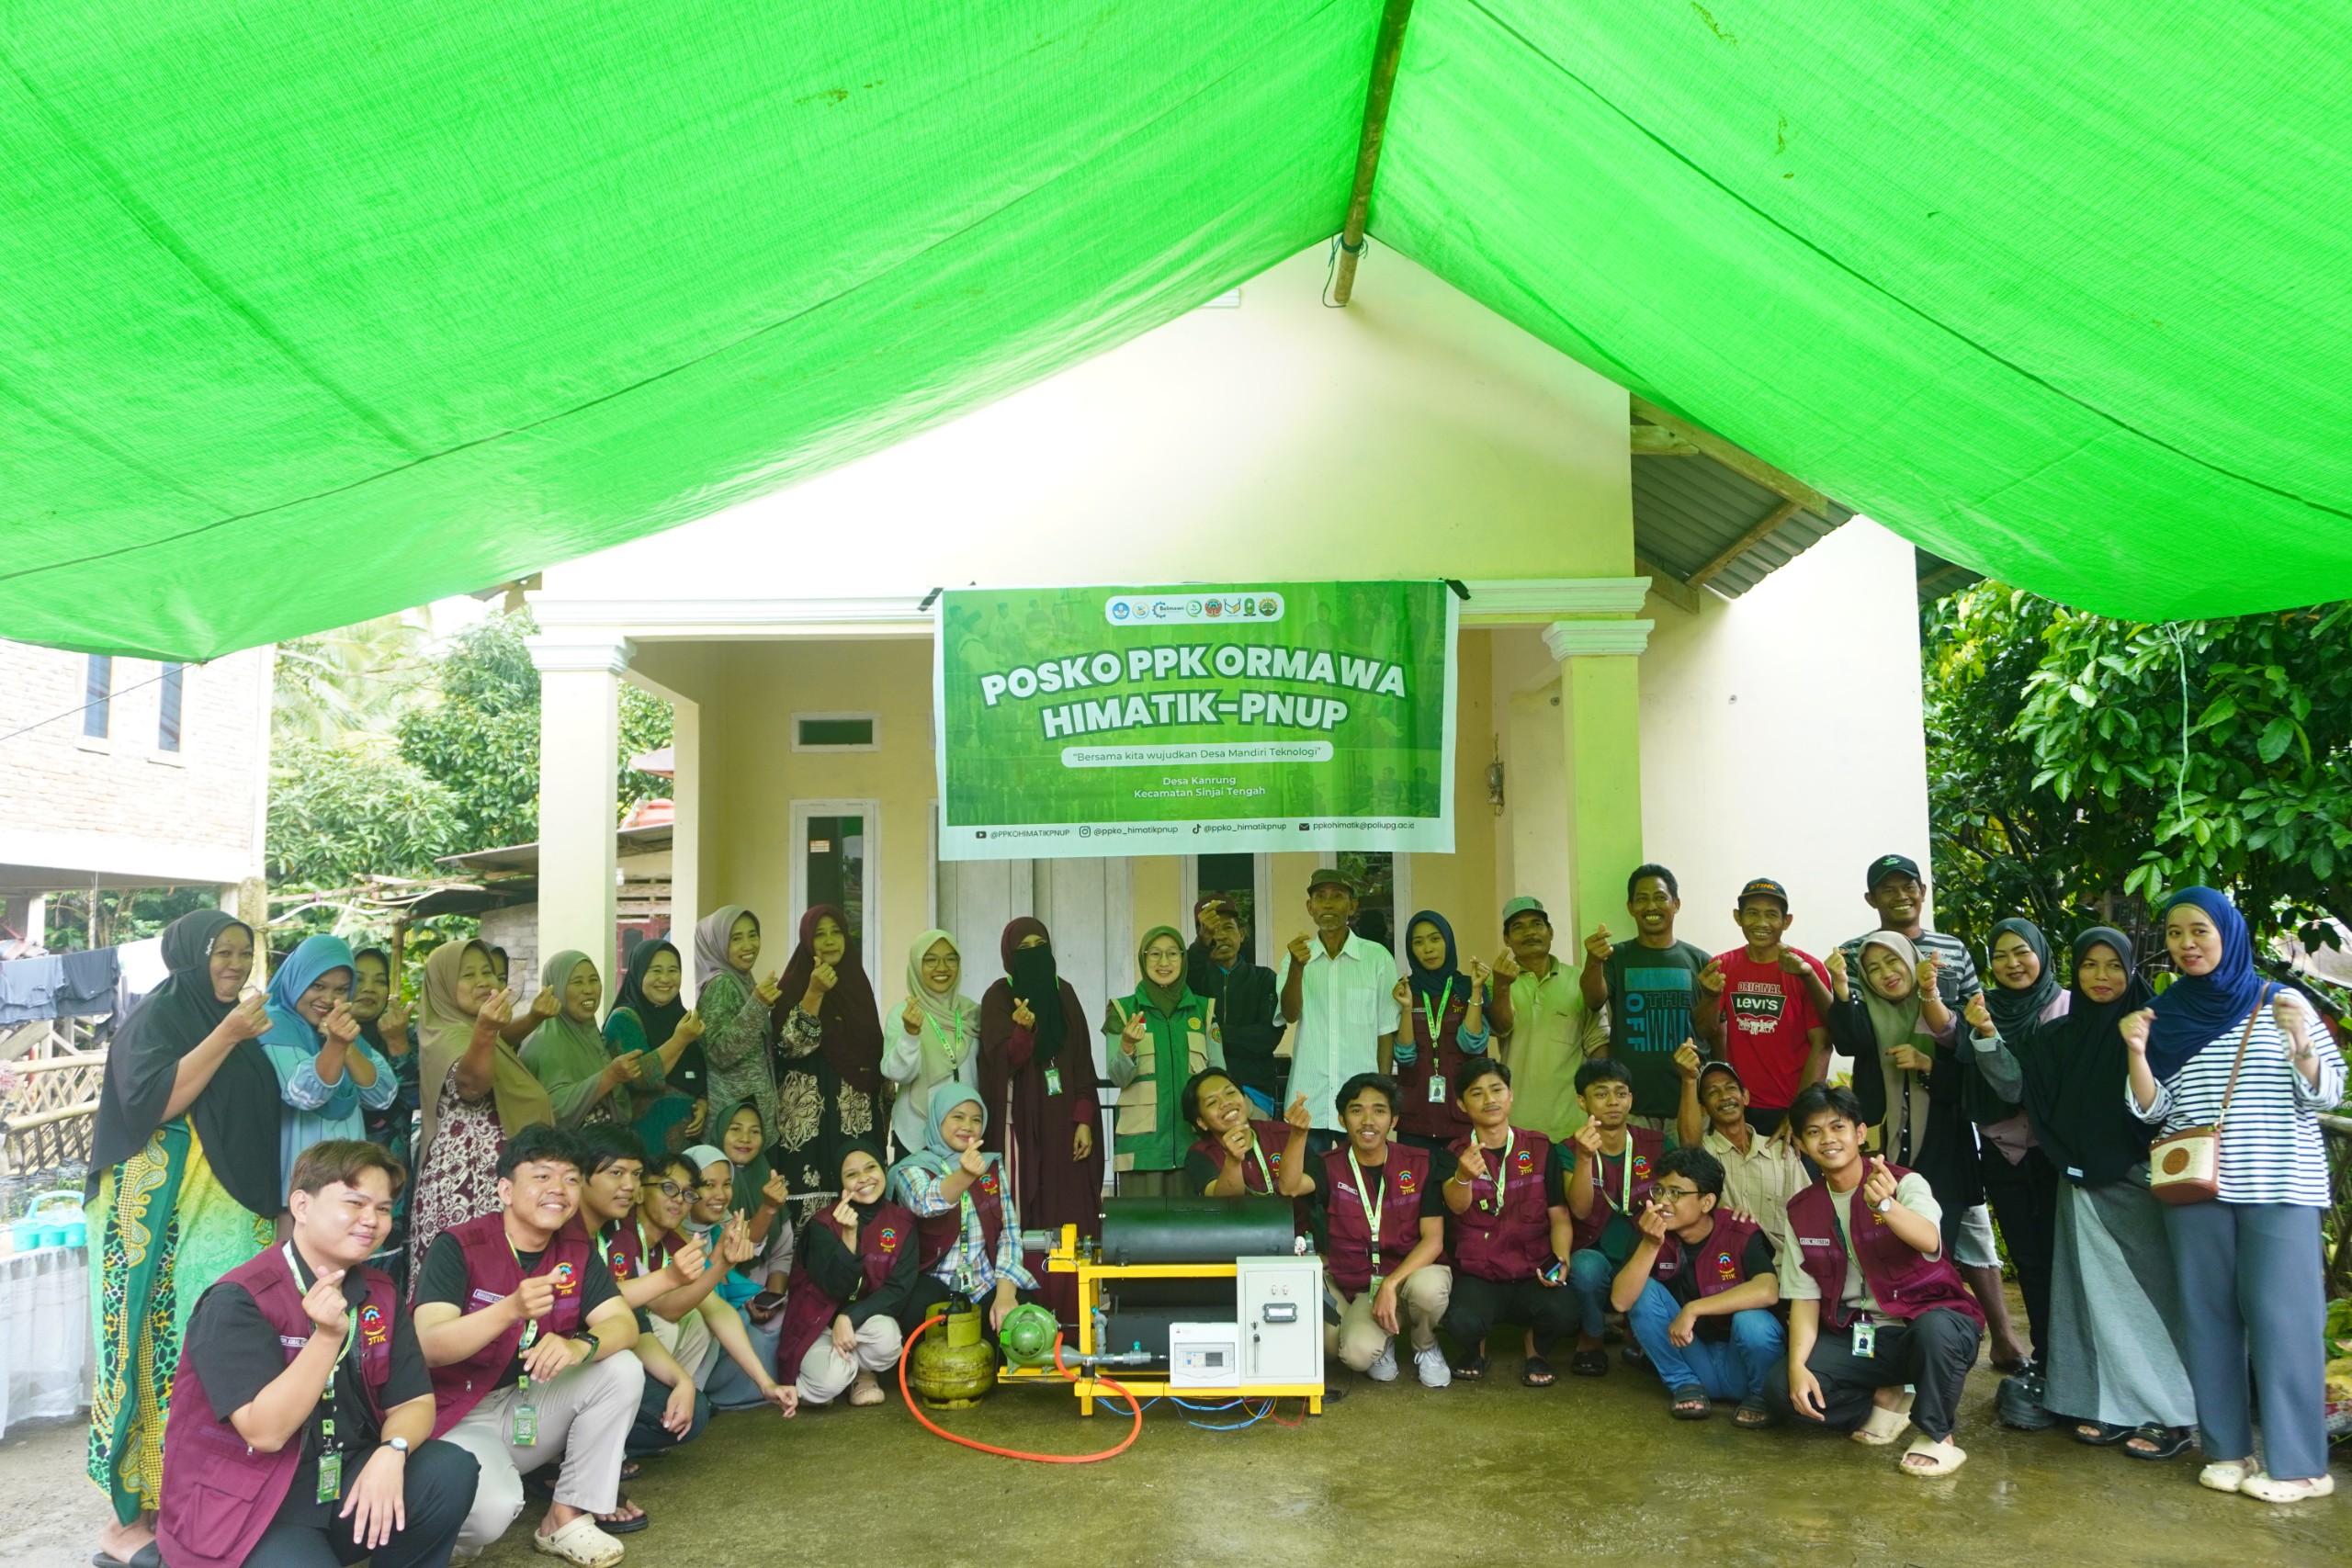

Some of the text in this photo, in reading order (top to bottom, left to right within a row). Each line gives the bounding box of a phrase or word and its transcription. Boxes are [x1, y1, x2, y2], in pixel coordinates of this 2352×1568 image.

[979, 645, 1407, 707] POSKO PPK ORMAWA
[1040, 691, 1349, 739] HIMATIK-PNUP
[1125, 750, 1144, 761] kita
[1147, 750, 1198, 761] wujudkan
[1200, 749, 1226, 759] Desa
[1228, 748, 1267, 758] Mandiri
[1162, 776, 1237, 787] Desa Kanrung
[1134, 786, 1266, 798] Kecamatan Sinjai Tengah
[1093, 825, 1179, 836] @ppko_himatikpnup
[1204, 822, 1287, 833] @ppko_himatikpnup
[1313, 821, 1415, 831] ppkohimatik@poliupg.ac.id
[990, 829, 1070, 839] @PPKOHIMATIKPNUP
[1737, 981, 1782, 995] ORIGINAL
[1645, 992, 1691, 1007] THE
[1626, 993, 1645, 1051] OFF
[368, 1335, 386, 1345] JTIK
